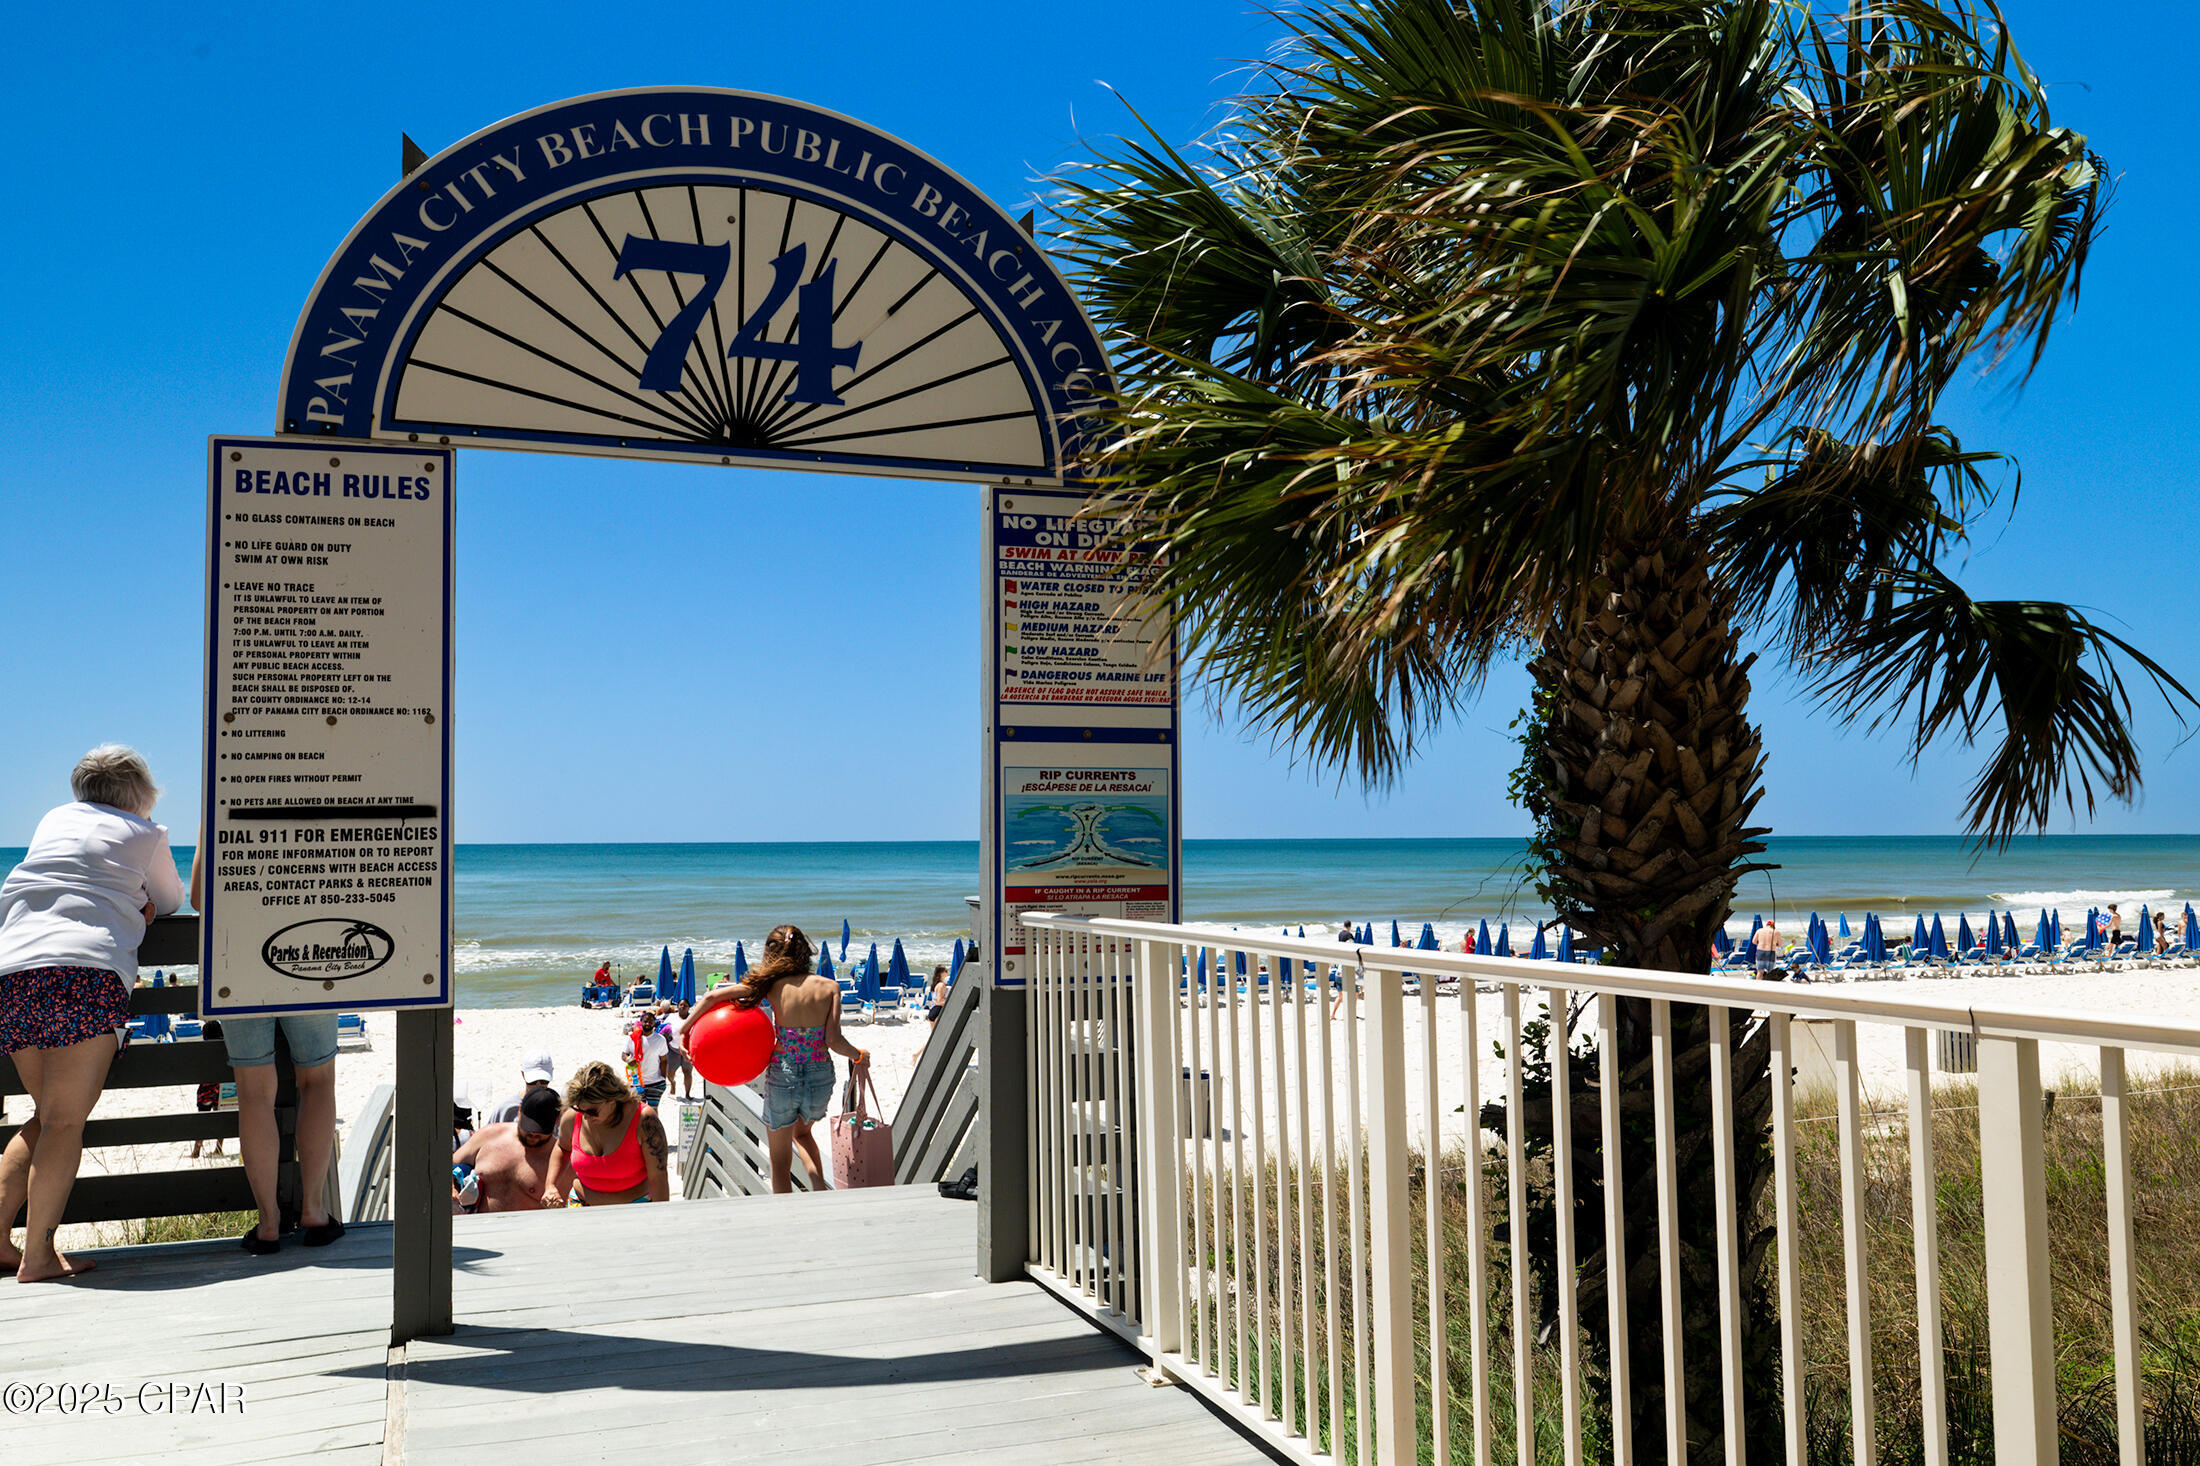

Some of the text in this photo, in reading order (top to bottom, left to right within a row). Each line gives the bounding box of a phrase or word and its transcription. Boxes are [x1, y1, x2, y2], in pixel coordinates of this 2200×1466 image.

[306, 232, 430, 426] PANAMA
[418, 146, 528, 231] CITY
[536, 113, 711, 169] BEACH
[730, 116, 907, 196] PUBLIC
[910, 182, 1046, 311] BEACH
[613, 233, 863, 406] 74
[235, 470, 429, 500] BEACH RULES
[235, 514, 394, 527] NO GLASS CONTAINERS ON BEACH
[1002, 516, 1037, 529] NO
[1034, 532, 1068, 546] ON
[234, 541, 351, 552] NO LIFE GUARD ON DUTY
[1005, 547, 1077, 561] SWIM AT
[234, 555, 328, 565] SWIM AT OWN RISK
[999, 561, 1045, 571] BEACH
[234, 582, 314, 592] LEAVE NO TRACE
[1020, 582, 1104, 593] WATER CLOSED
[254, 595, 296, 603] UNLAWFUL
[311, 596, 335, 604] LEAVE
[337, 596, 348, 604] AN
[350, 596, 369, 604] ITEM
[233, 606, 384, 616] PERSONAL PROPERTY ON ANY PORTION
[1019, 601, 1100, 611] HIGH HAZARD
[233, 617, 244, 625] OF
[246, 617, 261, 625] THE
[292, 618, 315, 626] FROM
[273, 629, 297, 637] UNTIL
[299, 629, 317, 637] 7:00
[318, 629, 336, 637] A.M.
[338, 629, 363, 637] DAILY.
[1020, 622, 1120, 634] MEDIUM HAZARD
[1020, 646, 1098, 656] LOW HAZARD
[232, 662, 249, 670] ANY
[251, 662, 280, 670] PUBLIC
[282, 662, 309, 670] BEACH
[232, 673, 254, 681] SUCH
[256, 673, 298, 681] PERSONAL
[342, 674, 361, 682] LEFT
[363, 674, 374, 682] ON
[376, 674, 391, 682] THE
[1020, 670, 1165, 682] DANGEROUS MARINE LIFE
[231, 696, 370, 704] BAY COUNTY ORDINANCE NO: 12-14
[231, 730, 285, 738] NO LITTERING
[230, 752, 324, 760] NO CAMPING ON BEACH
[230, 774, 361, 783] NO OPEN FIRES WITHOUT PERMIT
[1039, 770, 1136, 780] RIP CURRENTS
[1021, 783, 1151, 792] ¡ESCÁPESE DE LA RESACA!
[230, 798, 241, 806] NO
[244, 798, 264, 806] PETS
[284, 797, 321, 805] ALLOWED
[323, 797, 334, 805] ON
[337, 797, 363, 805] BEACH
[394, 796, 413, 804] TIME
[218, 827, 437, 844] DIAL 911 FOR EMERGENCIES
[222, 847, 433, 860] FOR MORE INFORMATION OR TO REPORT
[218, 861, 437, 876] ISSUES CONCERNS WITH BEACH ACCESS
[223, 877, 431, 892] AREAS, CONTACT PARKS & RECREATION
[261, 893, 395, 906] OFFICE AT 850-233-5045
[271, 943, 367, 962] Parks & Recreation
[291, 961, 365, 972] Panama City Beach
